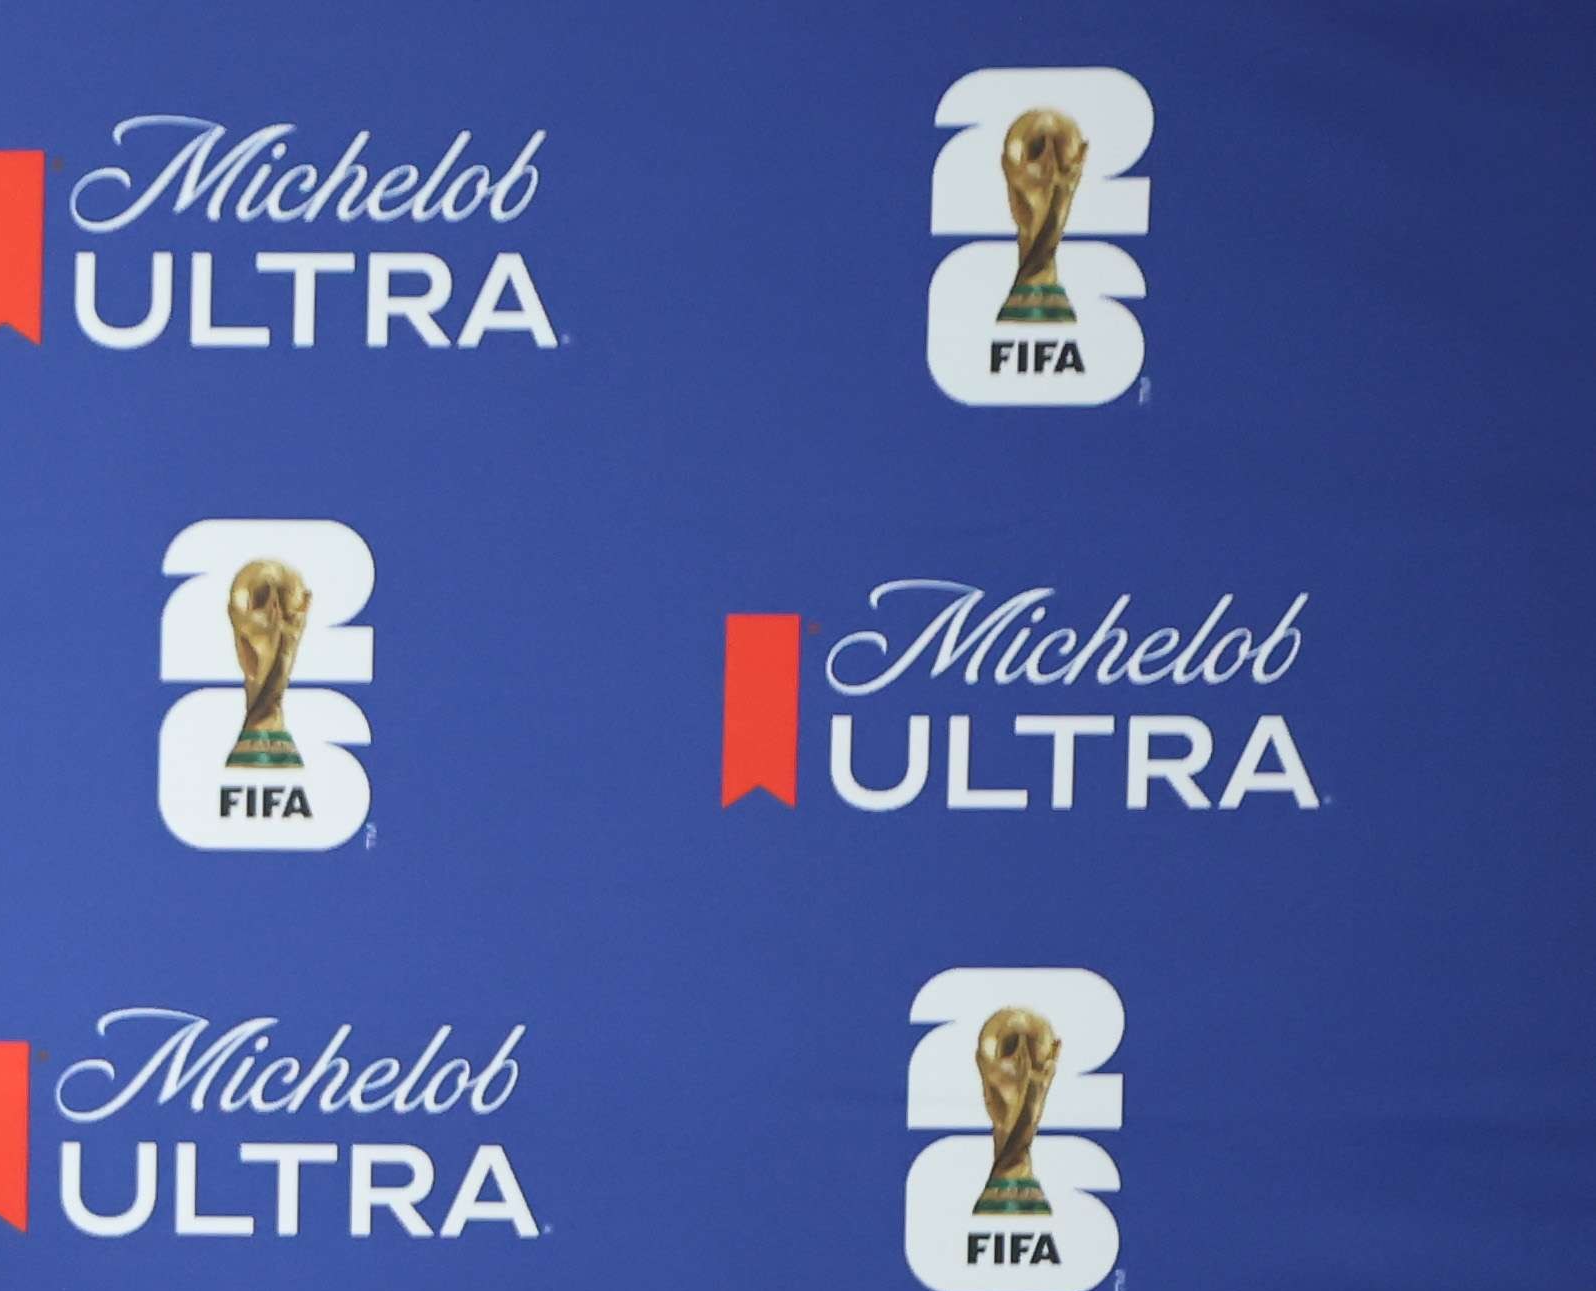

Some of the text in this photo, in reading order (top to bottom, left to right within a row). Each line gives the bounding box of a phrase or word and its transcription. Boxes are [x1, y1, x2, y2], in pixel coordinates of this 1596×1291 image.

[71, 117, 546, 232] Michelob
[75, 251, 558, 349] ULTRA
[989, 341, 1086, 374] FIFA
[826, 581, 1308, 695] Michelob
[219, 786, 313, 819] FIFA
[830, 715, 1320, 811] ULTRA
[56, 1008, 525, 1121] Michelob
[60, 1141, 539, 1238] ULTRA
[966, 1232, 1061, 1265] FIFA
